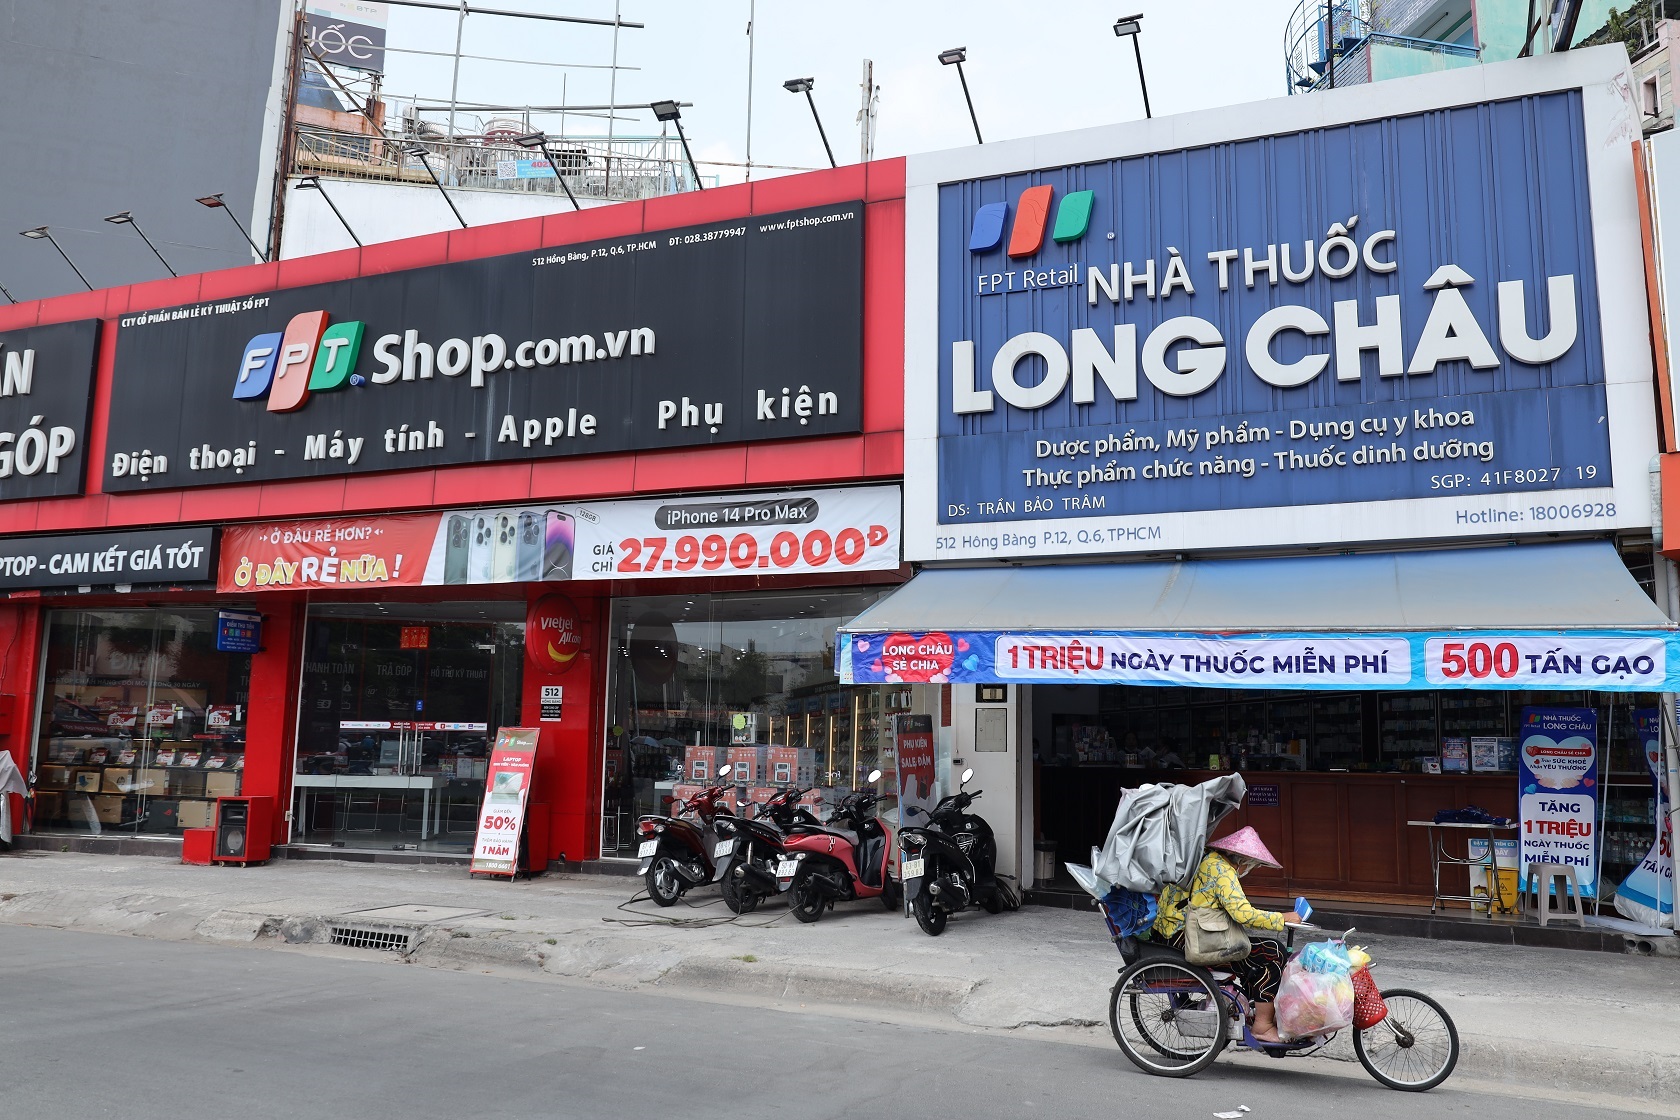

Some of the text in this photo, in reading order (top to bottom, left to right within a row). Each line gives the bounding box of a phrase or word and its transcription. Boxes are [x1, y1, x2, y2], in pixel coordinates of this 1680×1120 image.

[532, 211, 854, 267] 512 Hồng Bàng, P.12, Q.6, TP.HCM ĐT: 028.38779947 www.fptshop.com.vn
[1087, 214, 1399, 306] NHÀ THUỐC
[977, 262, 1079, 294] FPT Retail
[121, 318, 136, 328] CTY
[136, 311, 148, 326] CỔ
[171, 307, 190, 321] BÁN
[190, 304, 200, 319] LẺ
[201, 303, 213, 317] KỸ
[215, 299, 242, 315] THUẬT
[242, 295, 254, 311] SỐ
[254, 297, 270, 309] FPT
[952, 264, 1578, 415] LONG CHÂU
[371, 326, 656, 388] Shop.com.vn
[0, 342, 36, 397] N
[112, 449, 168, 483] Điện
[189, 440, 257, 475] thoại
[303, 429, 364, 465] Máy
[384, 420, 445, 454] tính
[497, 407, 597, 448] Apple
[658, 396, 724, 435] Phụ
[756, 384, 839, 426] kiện
[1036, 438, 1090, 461] Dược
[1095, 428, 1160, 458] phẩm,
[1166, 428, 1200, 453] Mỹ
[1205, 420, 1270, 451] phẩm
[1289, 419, 1355, 442] Dụng
[1360, 416, 1388, 438] cụ
[1393, 415, 1408, 437] y
[1413, 407, 1475, 429] khoa
[1022, 467, 1073, 490] Thực
[1077, 459, 1136, 489] phẩm
[1142, 457, 1194, 479] chức
[1199, 455, 1256, 479] năng
[1273, 444, 1347, 471] Thuốc
[1352, 442, 1407, 466] dinh
[1413, 438, 1494, 463] dưỡng
[1431, 465, 1597, 490] SGP: 41F8027 19
[667, 502, 808, 526] iPhone 14 Pro Max
[948, 494, 1106, 517] DS: TRẦN BẢO TRÂM
[1456, 502, 1617, 525] Hotline: 18006928
[270, 523, 373, 544] Ở ĐÂU RẺ HƠN?
[936, 526, 1162, 550] 512 Bàng P.12, Q.6, TPHCM
[49, 552, 90, 575] CAM
[92, 545, 128, 573] KẾT
[129, 545, 163, 571] GIÁ
[165, 540, 204, 569] TỐT
[234, 554, 252, 586] Ở
[255, 558, 300, 585] ĐÂY
[301, 546, 338, 584] RẺ
[339, 553, 389, 583] NỮA
[592, 541, 615, 573] GIÁ CHỈ
[882, 642, 953, 657] LONG CHÂU
[1006, 639, 1389, 675] 1 TRIỆU NGÀY THUỐC MIỄN PHÍ
[1441, 642, 1656, 681] 500 TẤN GẠO
[910, 659, 939, 671] CHIA
[544, 688, 560, 697] 512
[1542, 713, 1582, 722] NHÀ THUỐC
[1543, 721, 1592, 731] LONG CHÂU
[1538, 799, 1581, 815] TẶNG
[483, 815, 516, 831] 50%
[1524, 818, 1592, 838] 1 TRIỆU
[487, 844, 510, 856] NĂM
[1524, 838, 1590, 851] NGÀY THUỐC
[1524, 851, 1590, 867] MIỄN PHÍ
